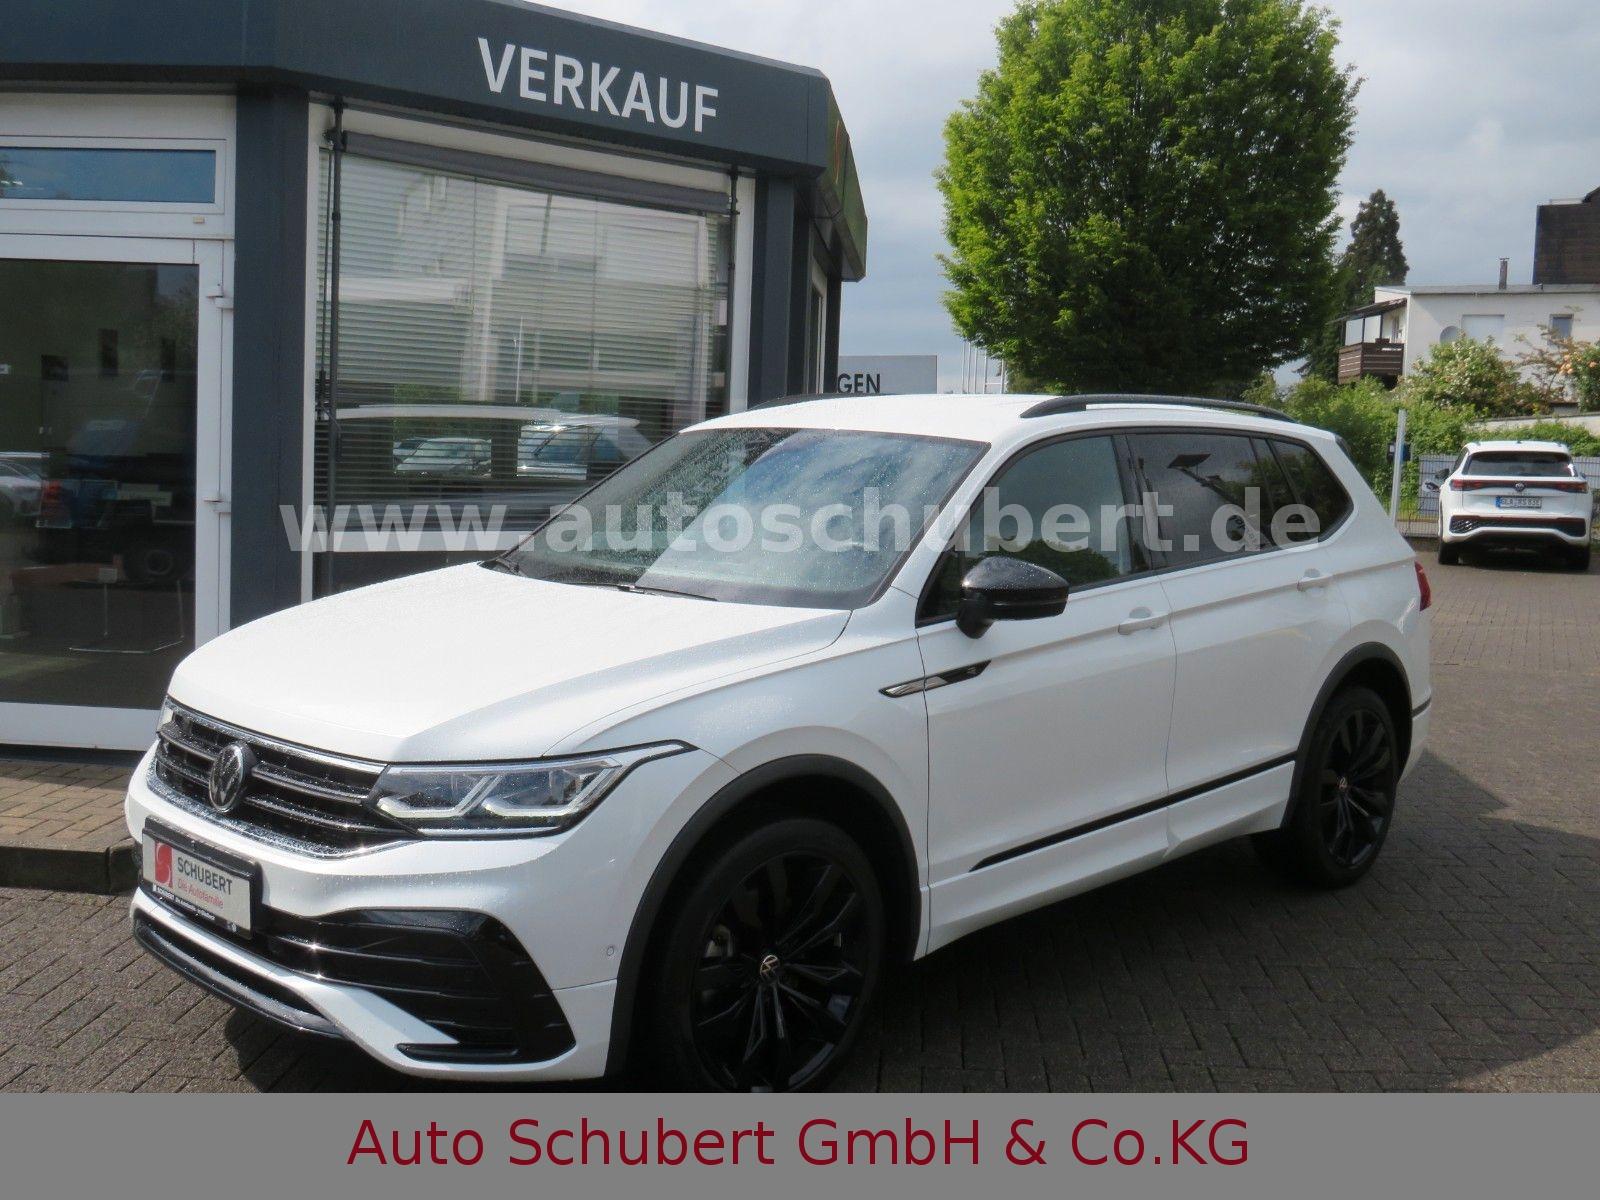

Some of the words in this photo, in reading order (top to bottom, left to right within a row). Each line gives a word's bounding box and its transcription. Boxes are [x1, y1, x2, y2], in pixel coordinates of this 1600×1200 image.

[477, 37, 719, 133] VERKAUF
[837, 373, 881, 394] GEN
[177, 857, 232, 895] SCHUBERT
